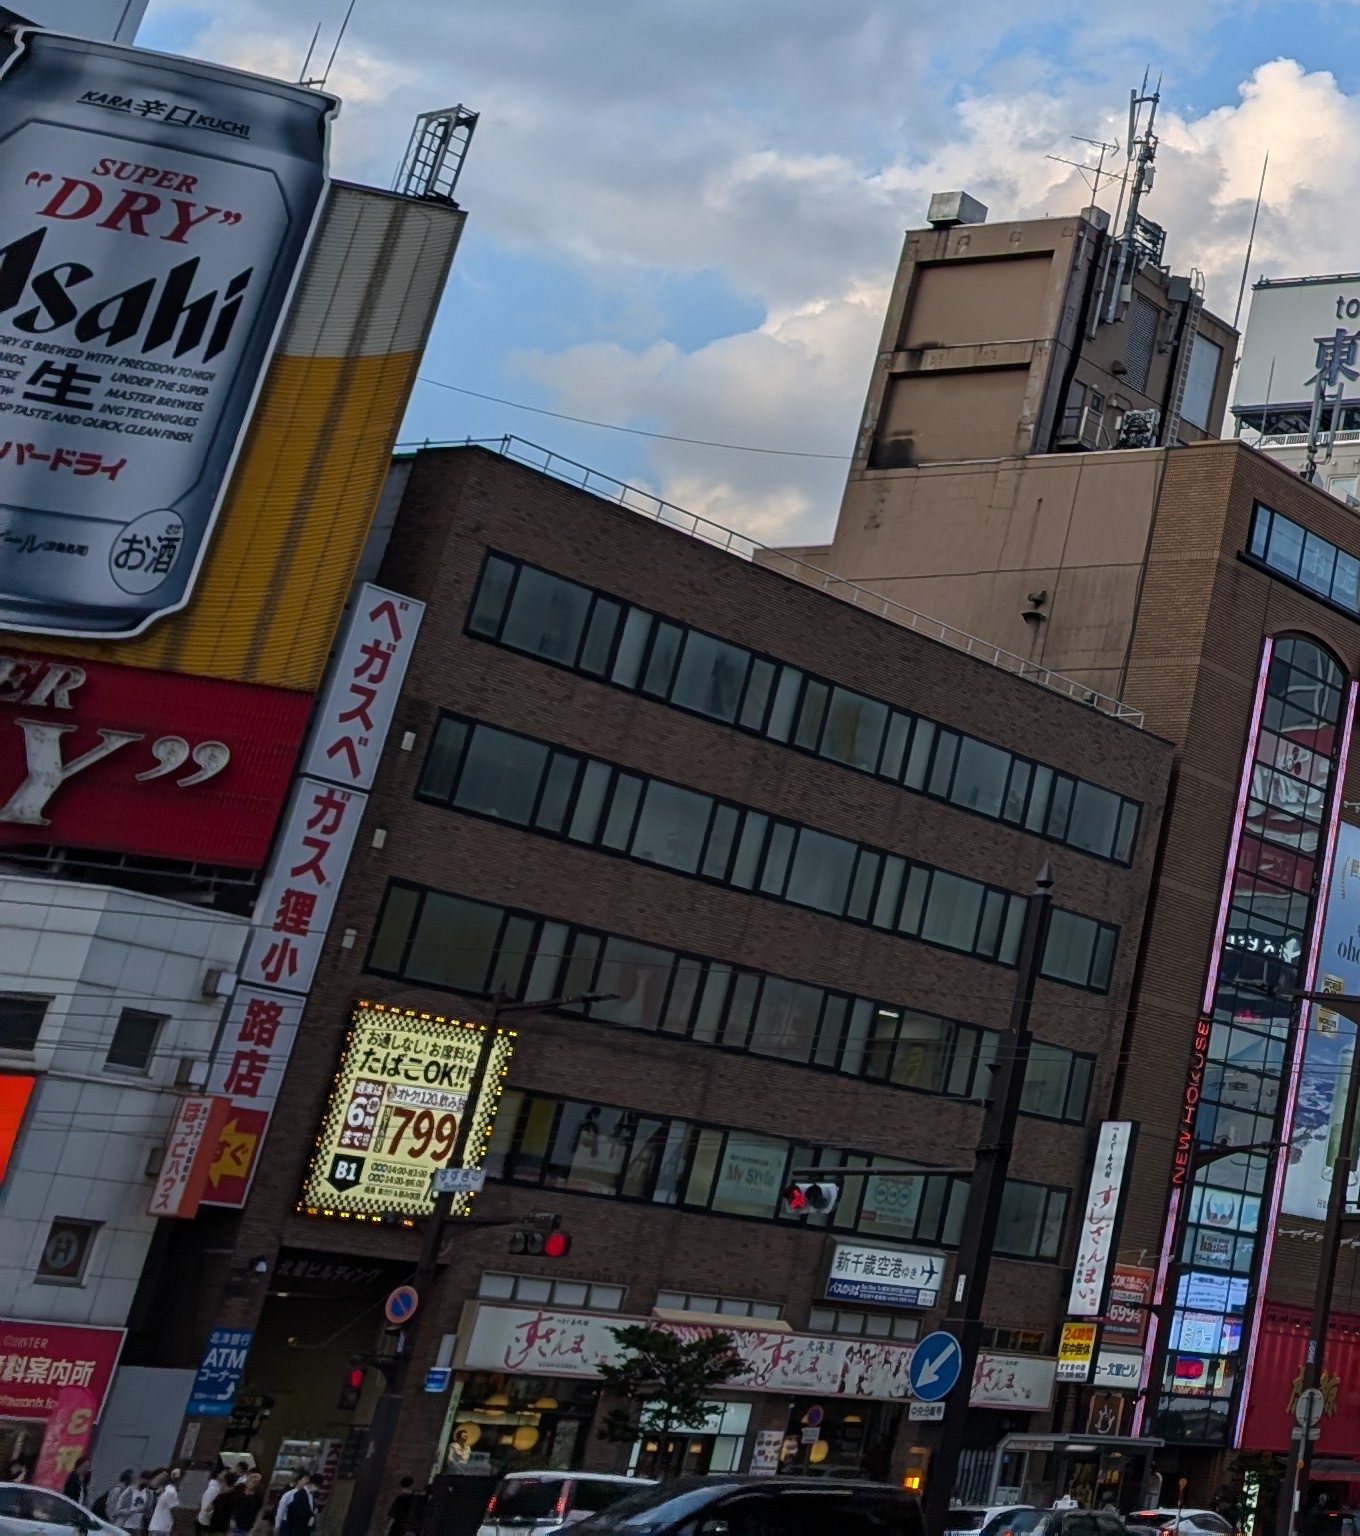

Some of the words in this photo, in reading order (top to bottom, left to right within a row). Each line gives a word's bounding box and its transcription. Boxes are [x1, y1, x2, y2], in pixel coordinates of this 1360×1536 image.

[81, 90, 132, 113] KARA
[134, 99, 197, 126] 辛口
[197, 113, 250, 136] KUCHI
[92, 158, 199, 194] SUPER
[20, 338, 28, 349] IS
[33, 341, 83, 359] BREWED
[85, 351, 118, 365] WITH
[118, 357, 177, 375] PRECISION
[23, 360, 102, 410] 生
[105, 388, 154, 404] MASTER
[110, 372, 157, 387] UNDER
[156, 380, 176, 392] THE
[15, 405, 52, 421] TASTE
[51, 413, 82, 424] AND
[124, 424, 161, 438] CLEAN
[126, 407, 199, 427] TECHNIQUES
[114, 534, 181, 574] お酒
[358, 1048, 468, 1088] たばこOK!!
[347, 1097, 367, 1128] 6
[388, 1107, 458, 1162] 799
[335, 1161, 357, 1181] B1
[1172, 1130, 1191, 1184] NEW
[1064, 1326, 1094, 1341] 24時間
[0, 1354, 96, 1388] 料案内所
[202, 1347, 247, 1369] ATM
[198, 1369, 241, 1383] コーナー
